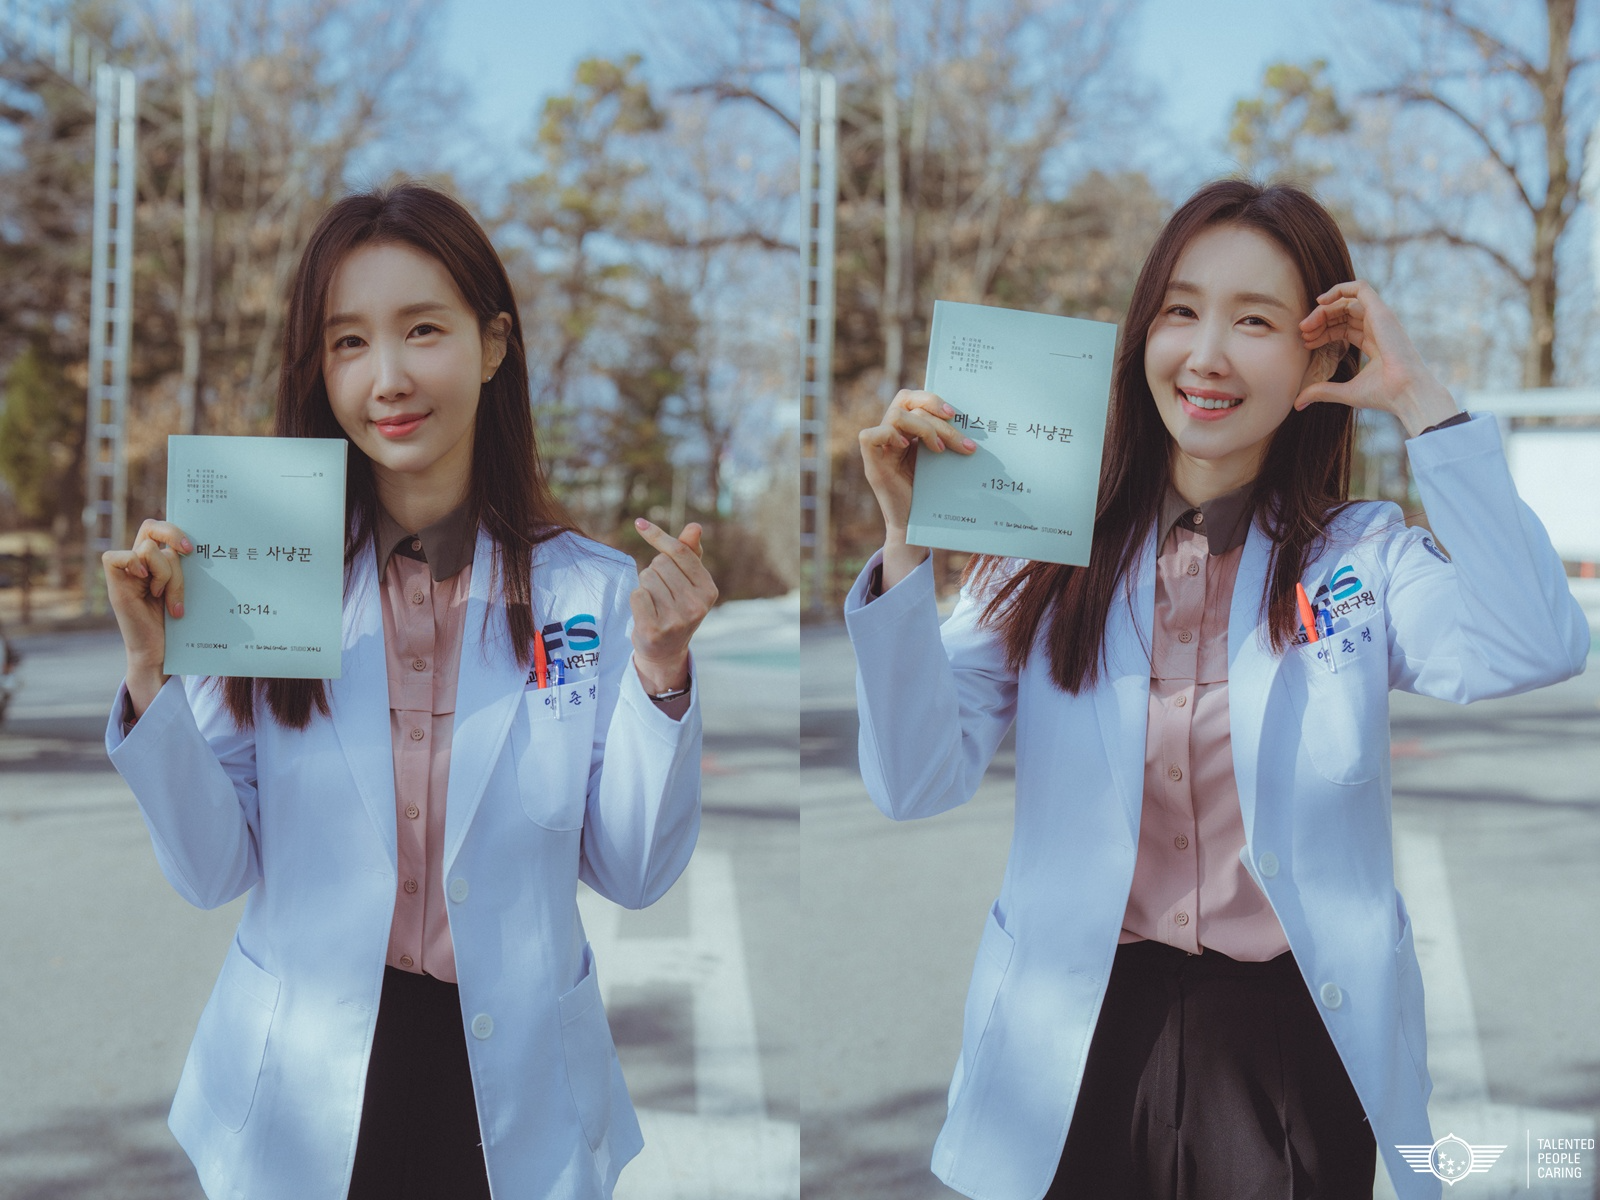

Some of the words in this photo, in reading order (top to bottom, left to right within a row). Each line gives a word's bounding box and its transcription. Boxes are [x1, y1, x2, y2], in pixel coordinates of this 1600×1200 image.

[954, 413, 999, 433] 메스를
[1006, 422, 1019, 436] 든
[1026, 423, 1074, 443] 사냥꾼
[990, 478, 1024, 493] 13~14
[196, 543, 239, 560] 메스를
[246, 547, 259, 560] 든
[266, 545, 313, 562] 사냥꾼
[237, 603, 270, 615] 13~14
